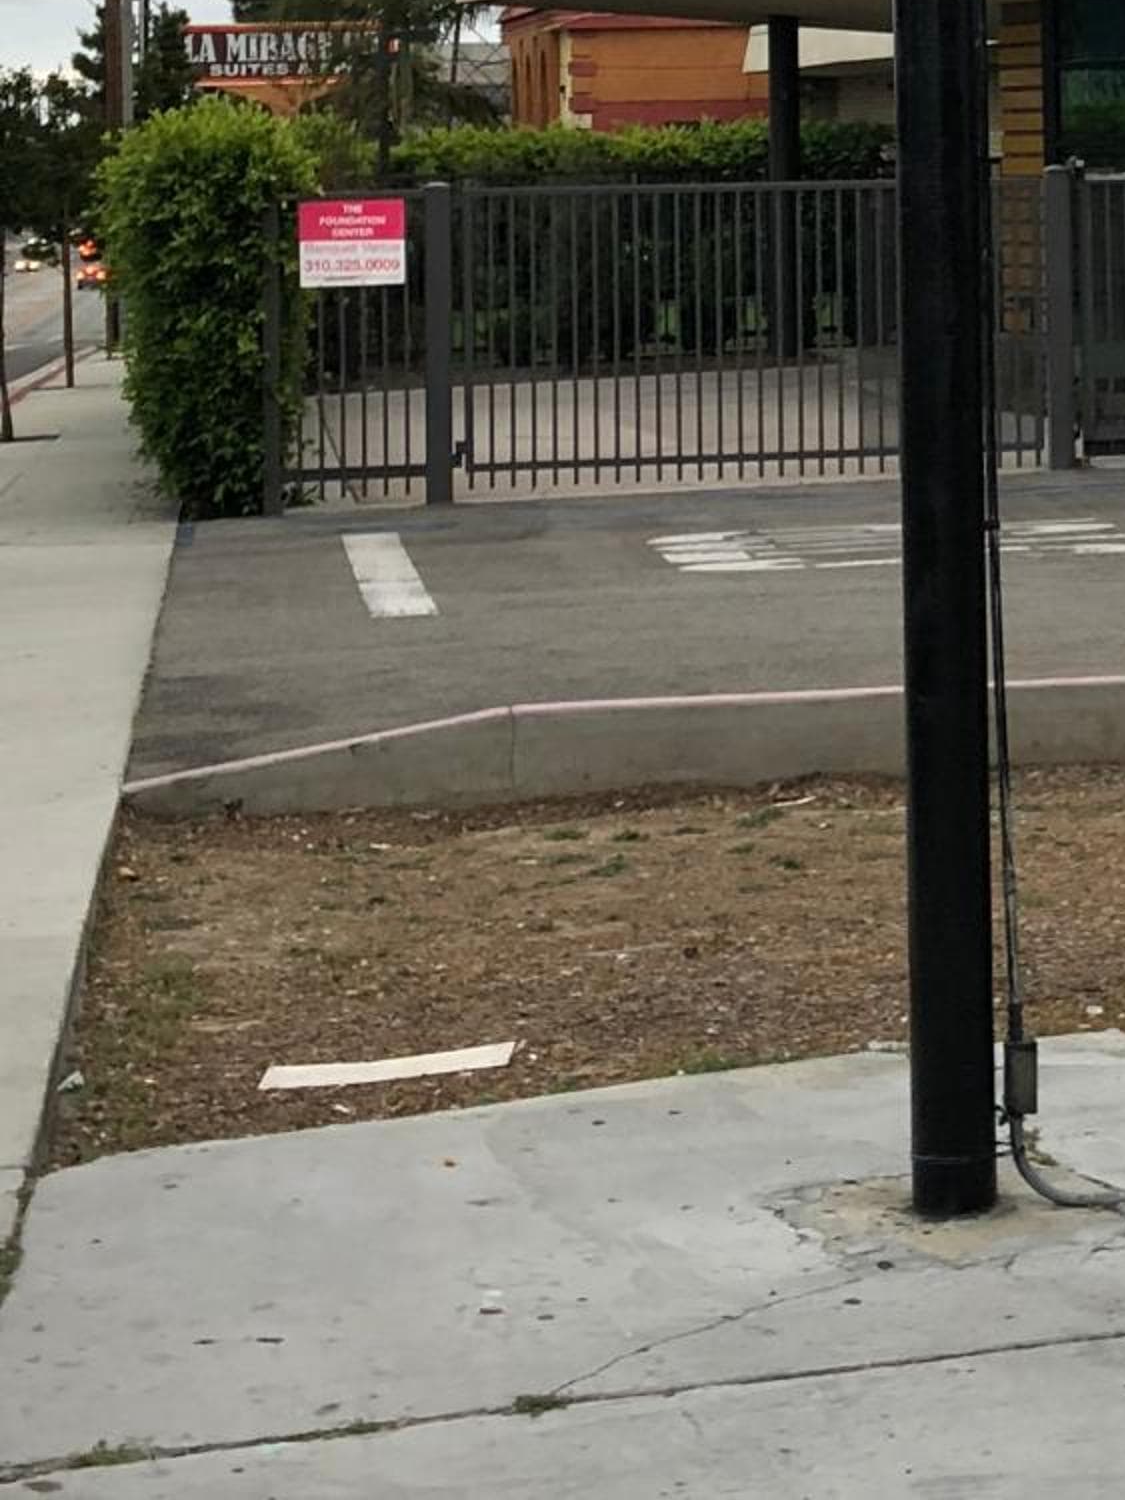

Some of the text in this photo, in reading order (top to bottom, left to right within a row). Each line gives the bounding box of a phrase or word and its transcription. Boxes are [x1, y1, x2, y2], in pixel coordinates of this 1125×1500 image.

[184, 33, 217, 62] LA
[226, 30, 333, 62] MIRAGE
[209, 63, 289, 77] SUITES
[343, 204, 363, 214] THE
